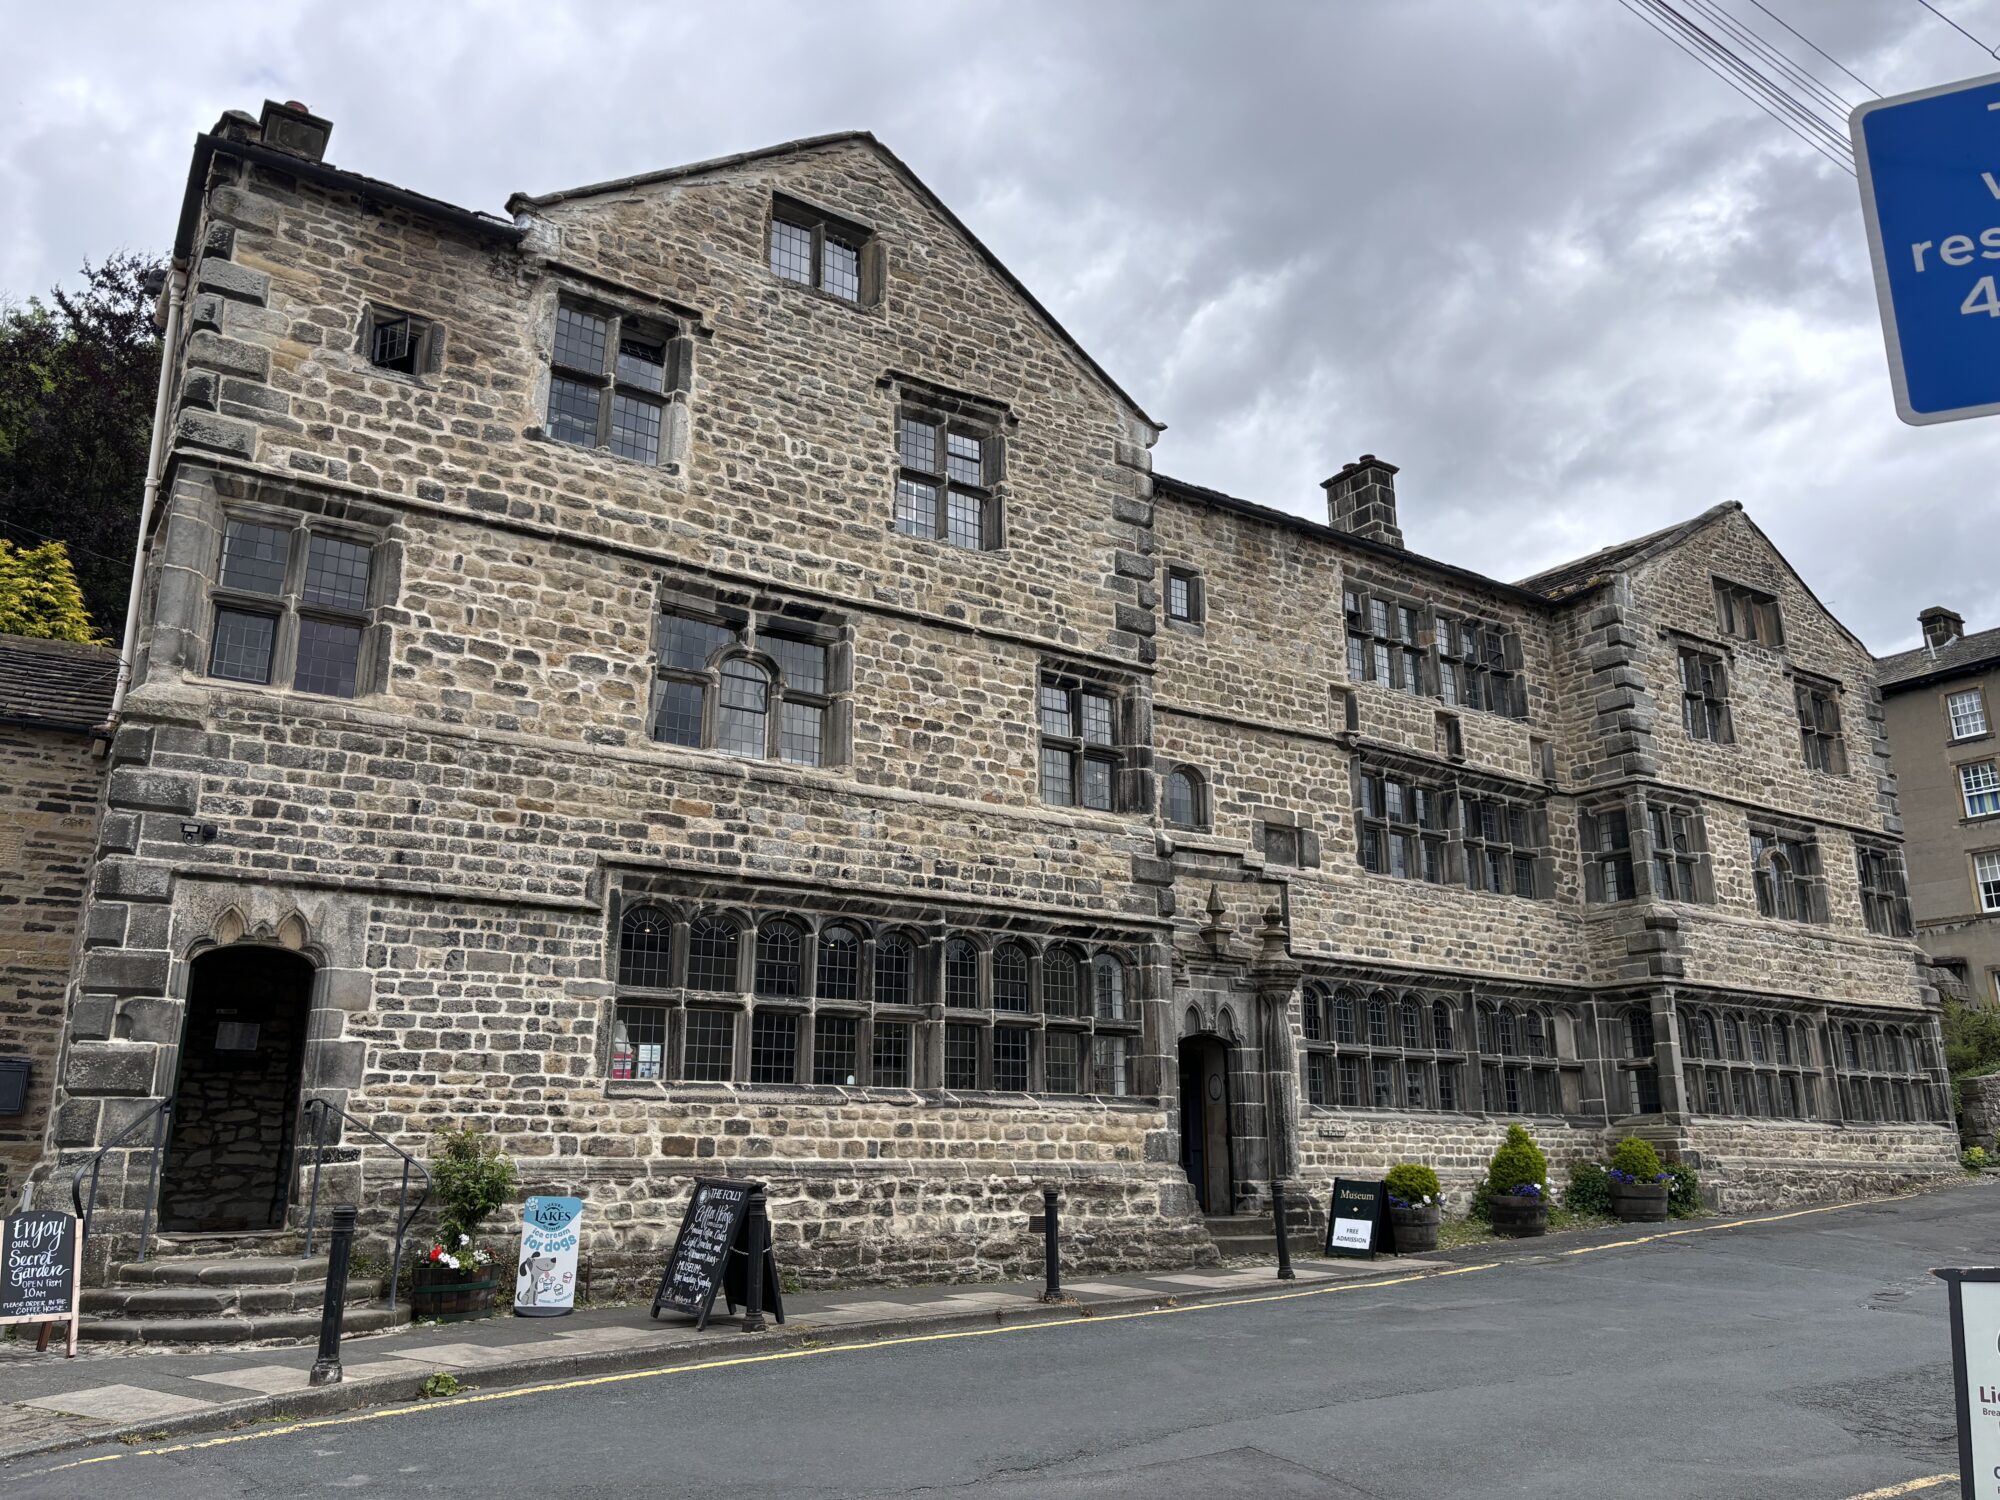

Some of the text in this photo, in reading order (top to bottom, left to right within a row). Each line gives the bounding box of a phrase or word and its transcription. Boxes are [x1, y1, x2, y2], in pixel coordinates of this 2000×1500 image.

[710, 1188, 743, 1202] THE FOLLY
[1340, 1189, 1374, 1201] Museum
[534, 1210, 572, 1225] LAKES
[12, 1214, 67, 1251] Enjoy!
[532, 1228, 571, 1239] ice cream
[1346, 1227, 1359, 1235] FREE
[11, 1240, 31, 1249] OUR
[523, 1234, 577, 1253] for dogs
[1336, 1235, 1367, 1244] ADMISSION
[8, 1250, 57, 1268] Secret
[10, 1265, 70, 1287] Garden
[22, 1279, 44, 1289] OPEN
[16, 1307, 41, 1315] COFFEE
